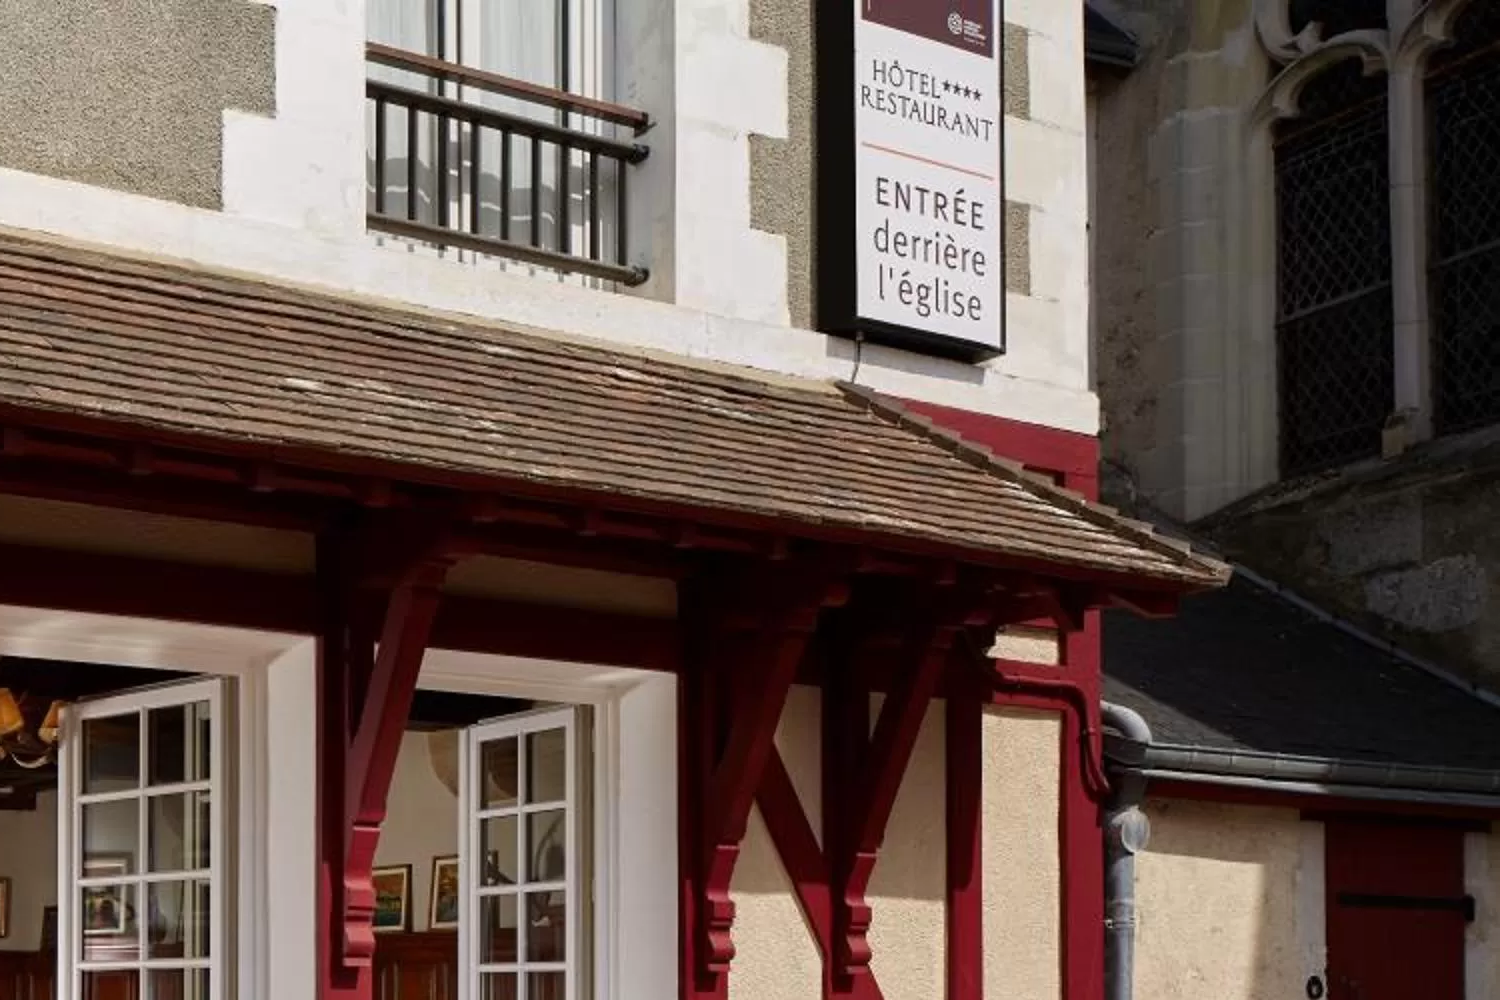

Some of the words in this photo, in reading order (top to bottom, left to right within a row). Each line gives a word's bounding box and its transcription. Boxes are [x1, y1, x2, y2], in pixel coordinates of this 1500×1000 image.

[873, 59, 940, 99] HÔTEL
[861, 84, 993, 141] RESTAURANT
[876, 176, 984, 230] ENTRÉE
[874, 218, 985, 276] derrière
[879, 263, 981, 320] l'église
